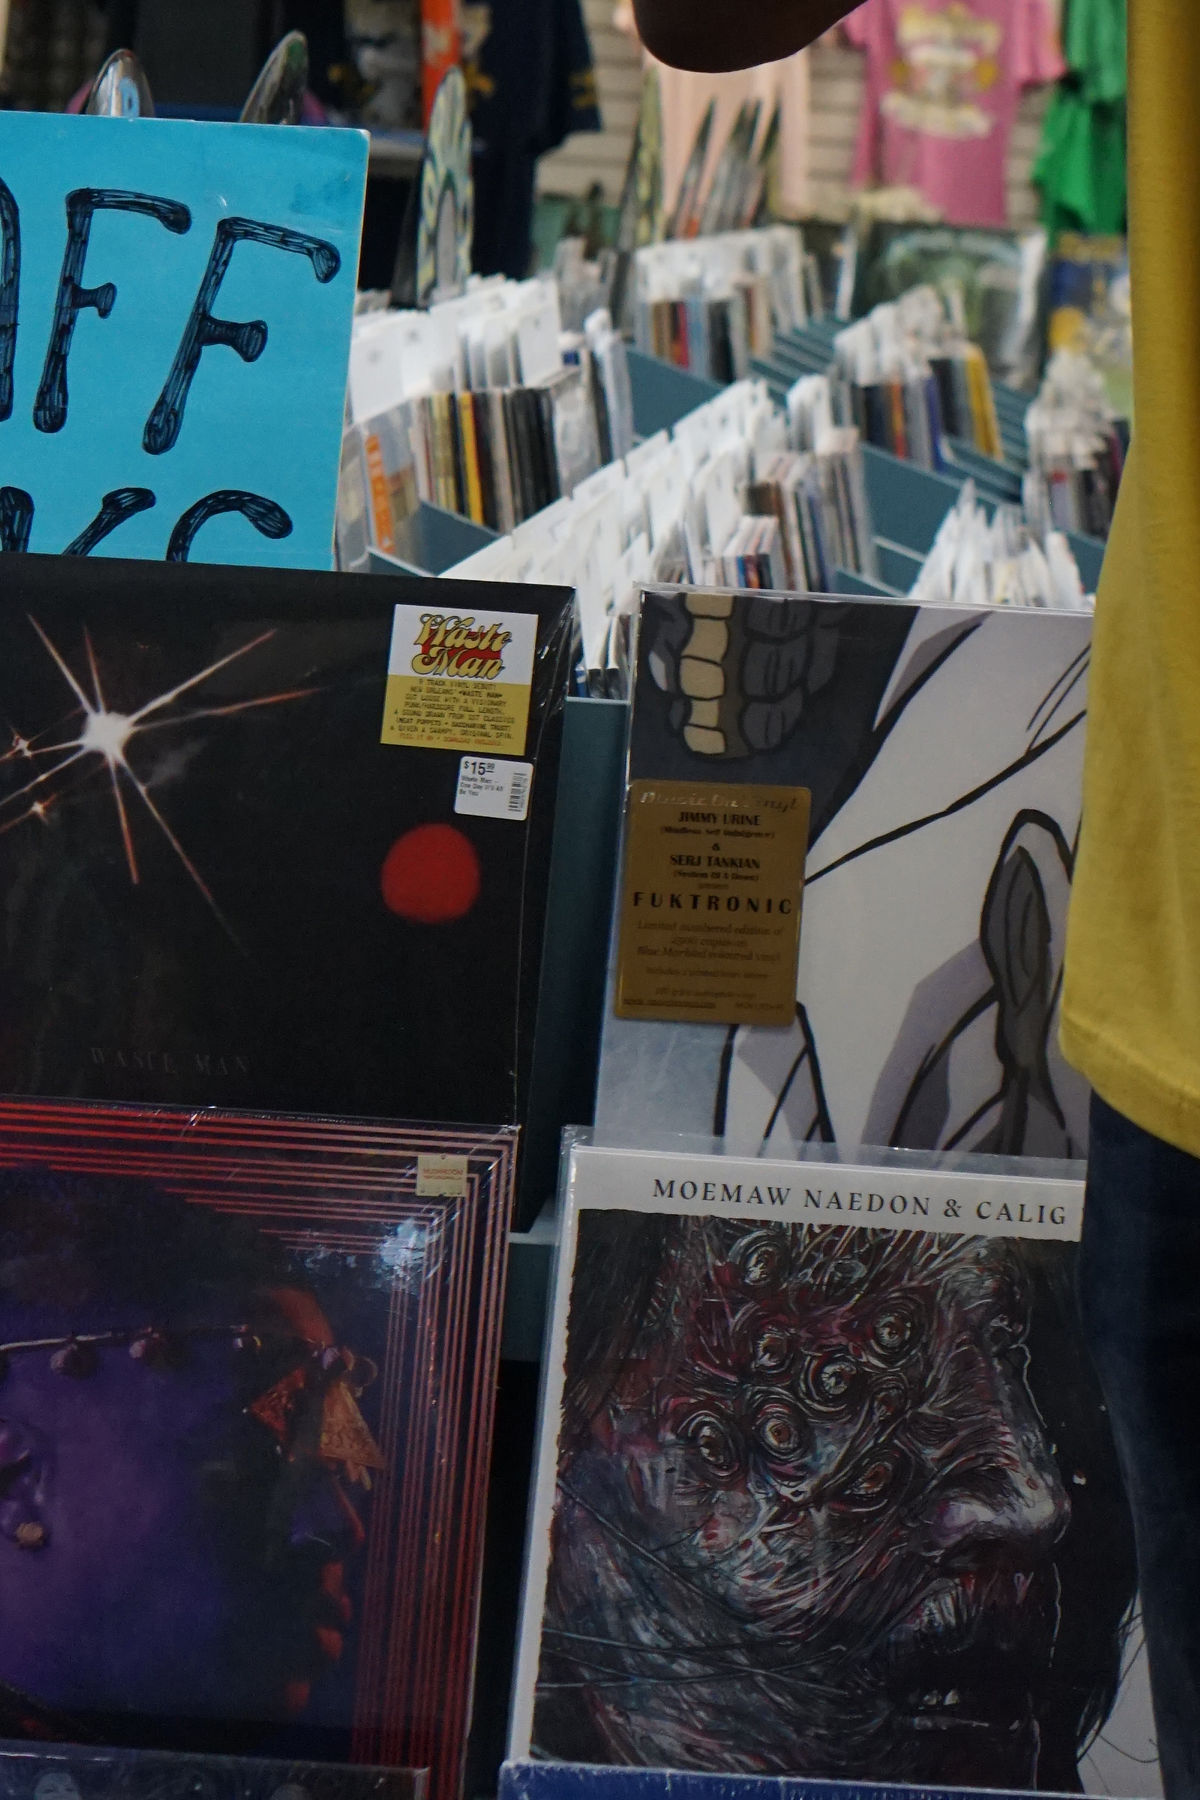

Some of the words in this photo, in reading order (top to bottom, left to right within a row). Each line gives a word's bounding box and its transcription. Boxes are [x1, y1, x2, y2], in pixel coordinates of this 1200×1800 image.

[413, 613, 512, 652] Waste
[411, 645, 506, 680] Man
[678, 811, 718, 824] JIMMY
[670, 854, 702, 866] SERJ
[706, 856, 761, 869] TANKIAN
[633, 891, 793, 915] FUKTRONIC
[652, 1177, 792, 1207] MOEMAW
[803, 1189, 932, 1217] NAEDON
[942, 1198, 963, 1218] &
[975, 1200, 1068, 1226] CALIG
